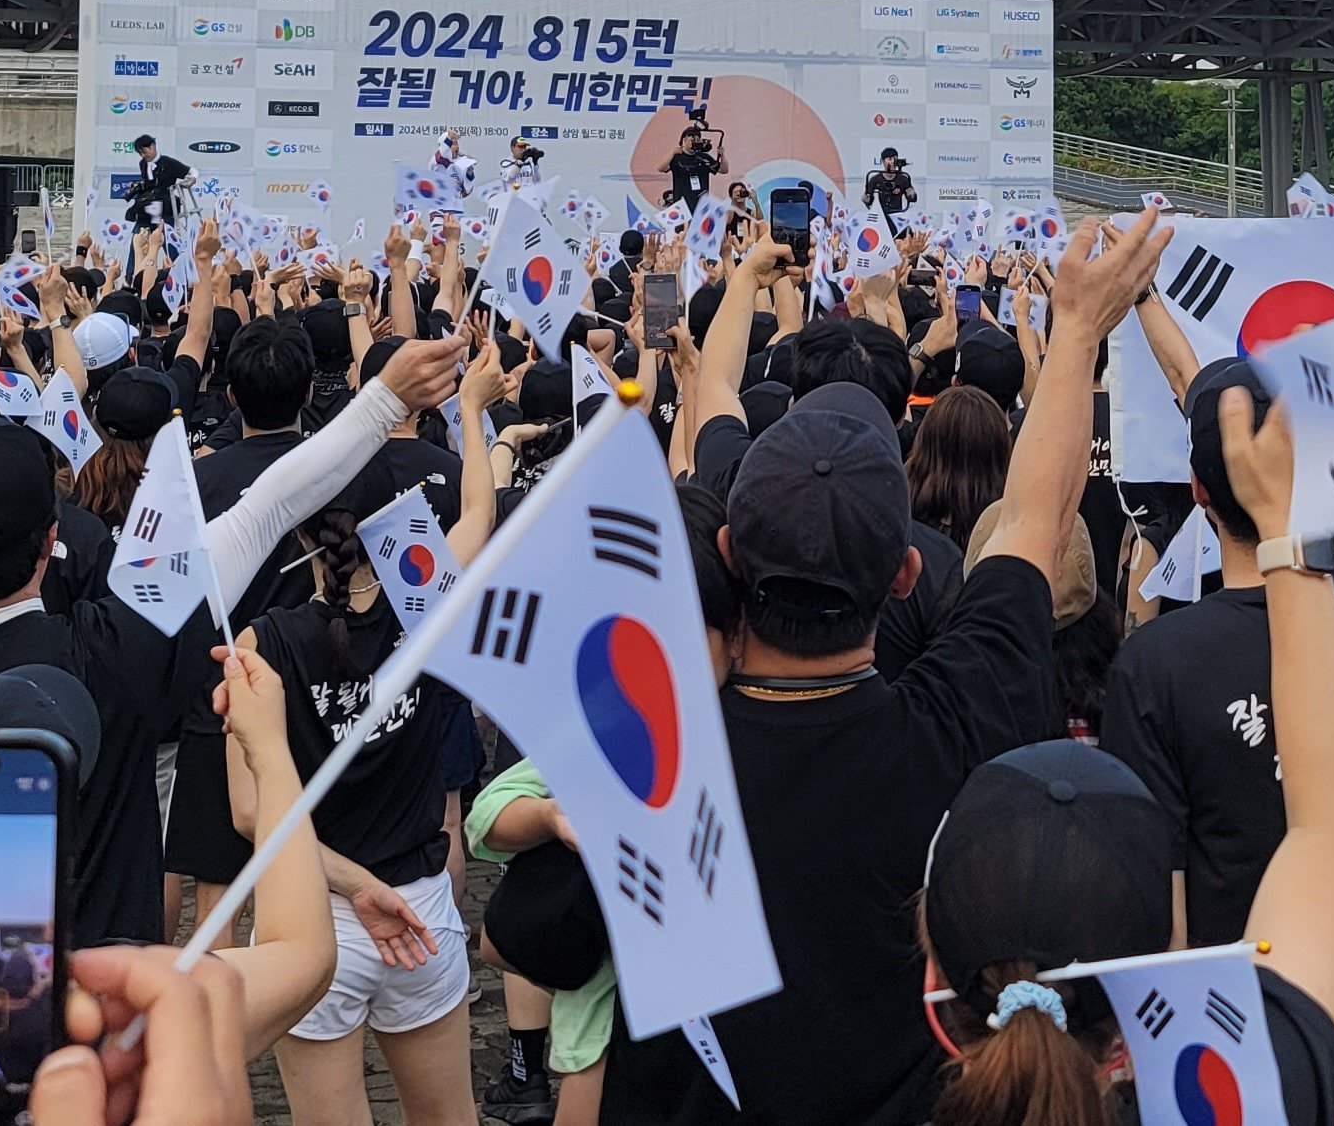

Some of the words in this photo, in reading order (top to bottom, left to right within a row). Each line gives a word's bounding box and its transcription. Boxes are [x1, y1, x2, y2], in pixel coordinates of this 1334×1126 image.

[874, 7, 889, 17] LIG
[891, 7, 913, 17] Nex1
[936, 8, 950, 17] LIG
[951, 9, 980, 19] System
[1003, 11, 1040, 21] HUSECO
[211, 23, 226, 33] GS
[295, 25, 315, 38] DB
[364, 10, 504, 59] 2024
[528, 15, 680, 68] 815런
[191, 63, 235, 75] 금호건설
[356, 67, 436, 109] 잘될
[449, 69, 534, 112] 거야,
[547, 72, 713, 115] 대한민국!
[129, 100, 144, 111] GS
[145, 101, 162, 111] 파워
[1013, 118, 1026, 128] GS
[365, 124, 384, 135] 일시
[398, 126, 431, 136] 2024년
[432, 126, 448, 136] 8월
[484, 128, 509, 137] 18:00
[530, 127, 549, 138] 장소
[562, 128, 579, 139] 상암
[581, 128, 606, 140] 월드컵
[608, 129, 626, 140] 공원
[283, 144, 297, 153] GS
[299, 144, 321, 154] 칼텍스
[310, 681, 334, 718] 잘
[1225, 693, 1268, 749] 잘
